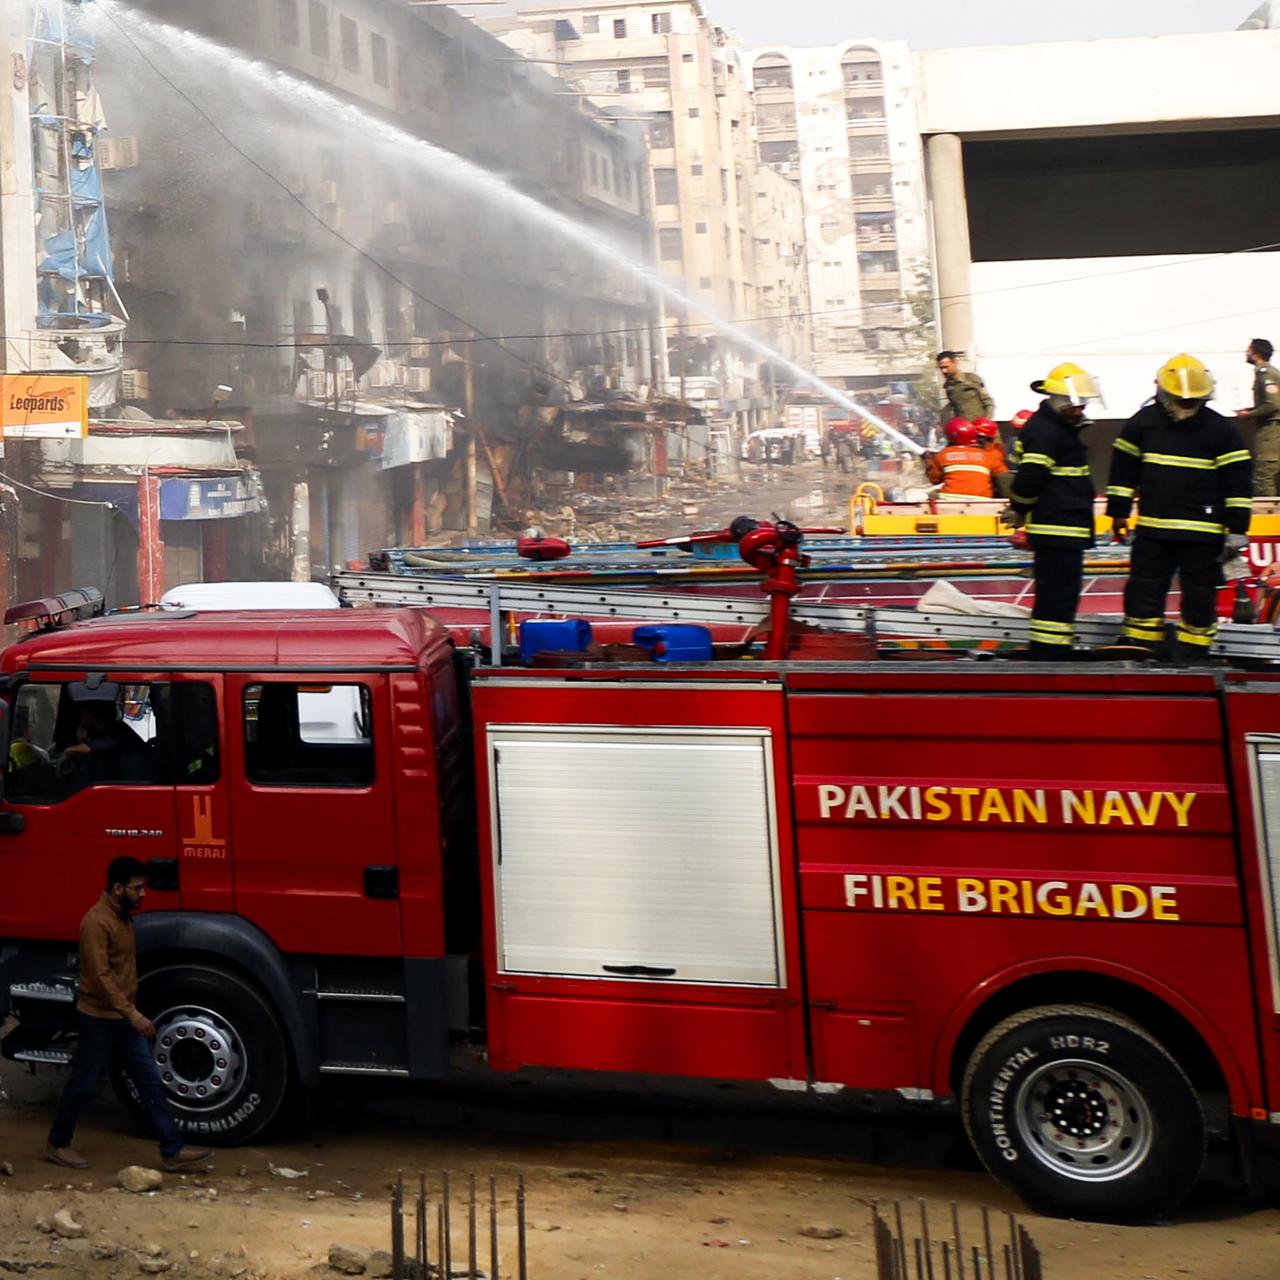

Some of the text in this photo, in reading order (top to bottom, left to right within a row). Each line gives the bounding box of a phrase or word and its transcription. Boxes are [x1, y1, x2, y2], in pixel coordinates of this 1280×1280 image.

[9, 393, 66, 414] Leopards
[817, 784, 1198, 828] PAKISTAN NAVY
[183, 846, 226, 860] MERAJ
[843, 873, 1180, 922] FIRE BRIGADE
[1049, 1035, 1111, 1055] HDR2
[989, 1046, 1039, 1161] CONTINENTAL
